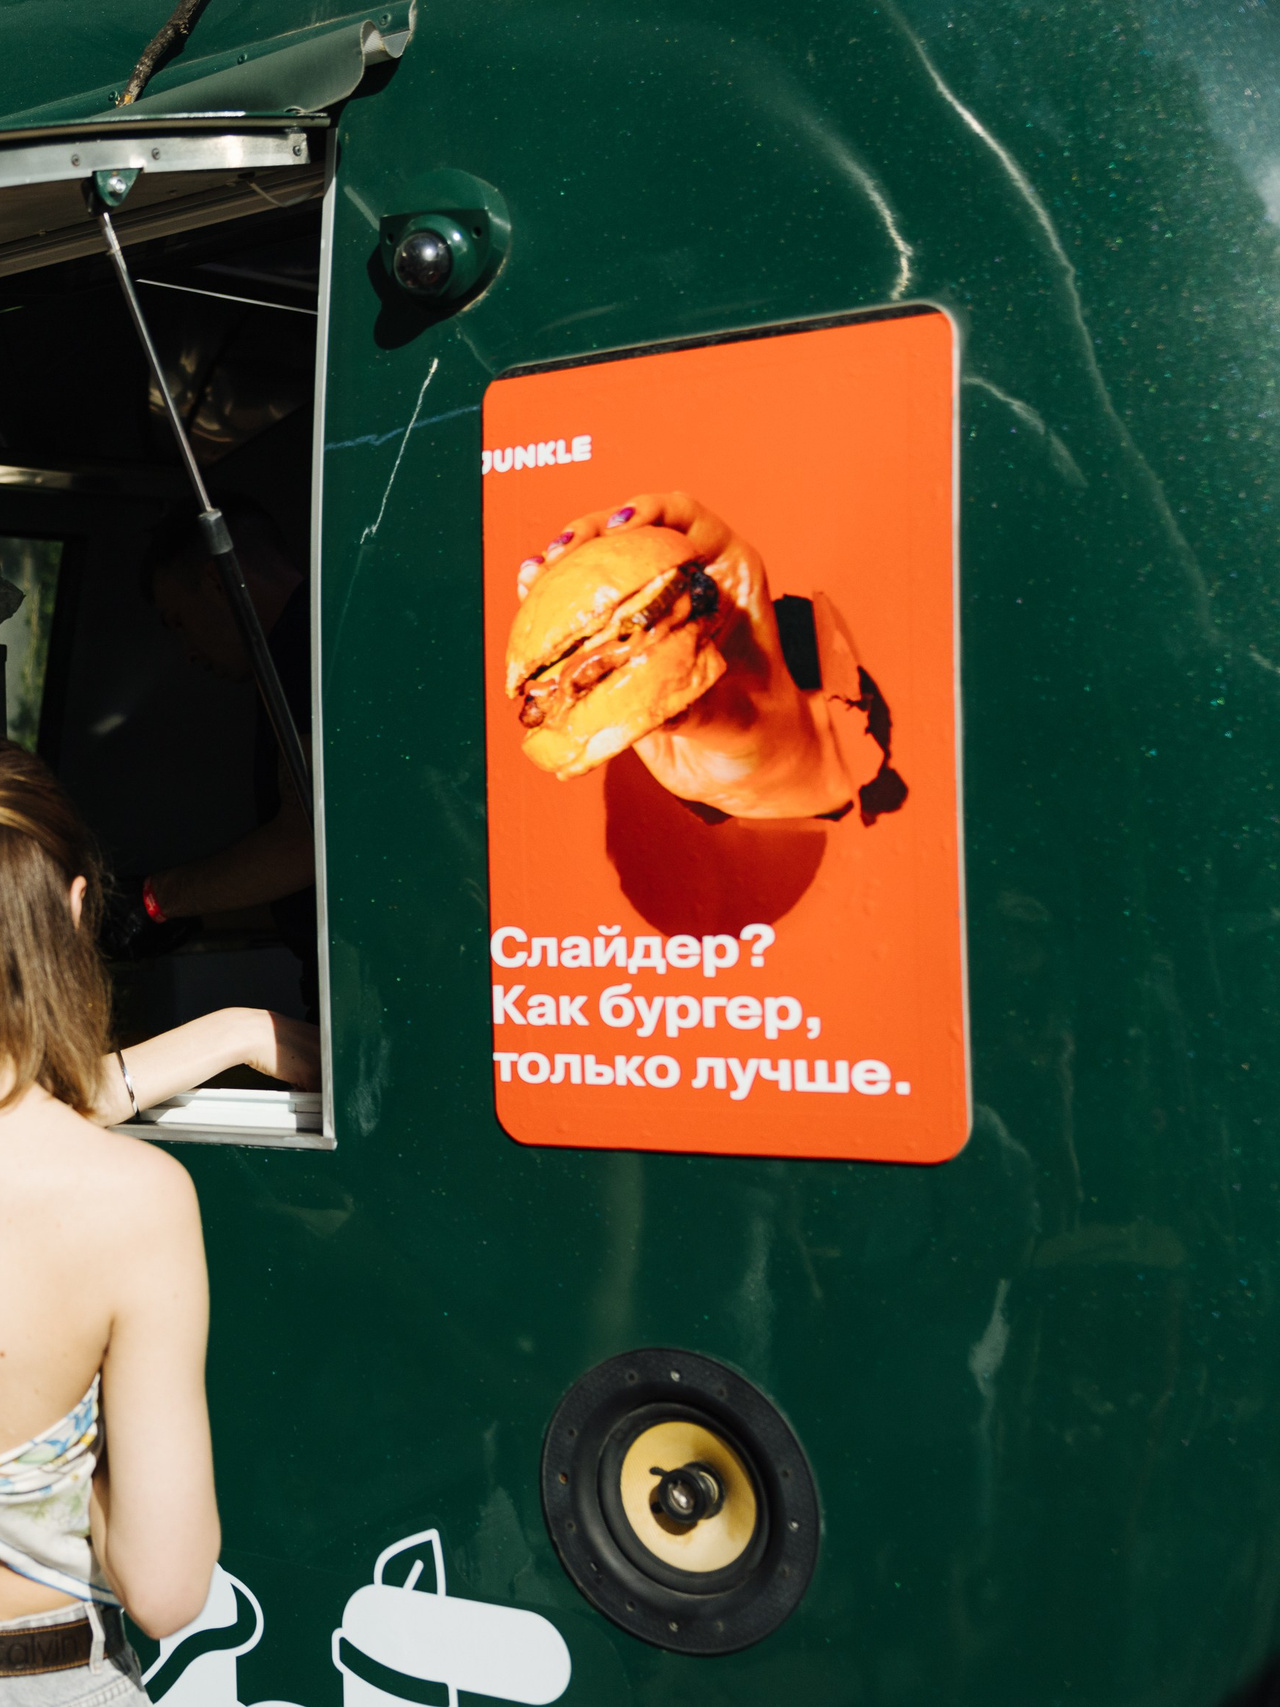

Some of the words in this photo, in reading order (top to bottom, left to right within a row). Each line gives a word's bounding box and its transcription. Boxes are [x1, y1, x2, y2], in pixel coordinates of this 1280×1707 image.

[482, 434, 592, 475] JUNKLE
[490, 923, 776, 977] Слайдер?
[492, 984, 589, 1026] Как
[599, 983, 821, 1039] бургер,
[492, 1050, 681, 1087] только
[692, 1056, 911, 1100] лучше.
